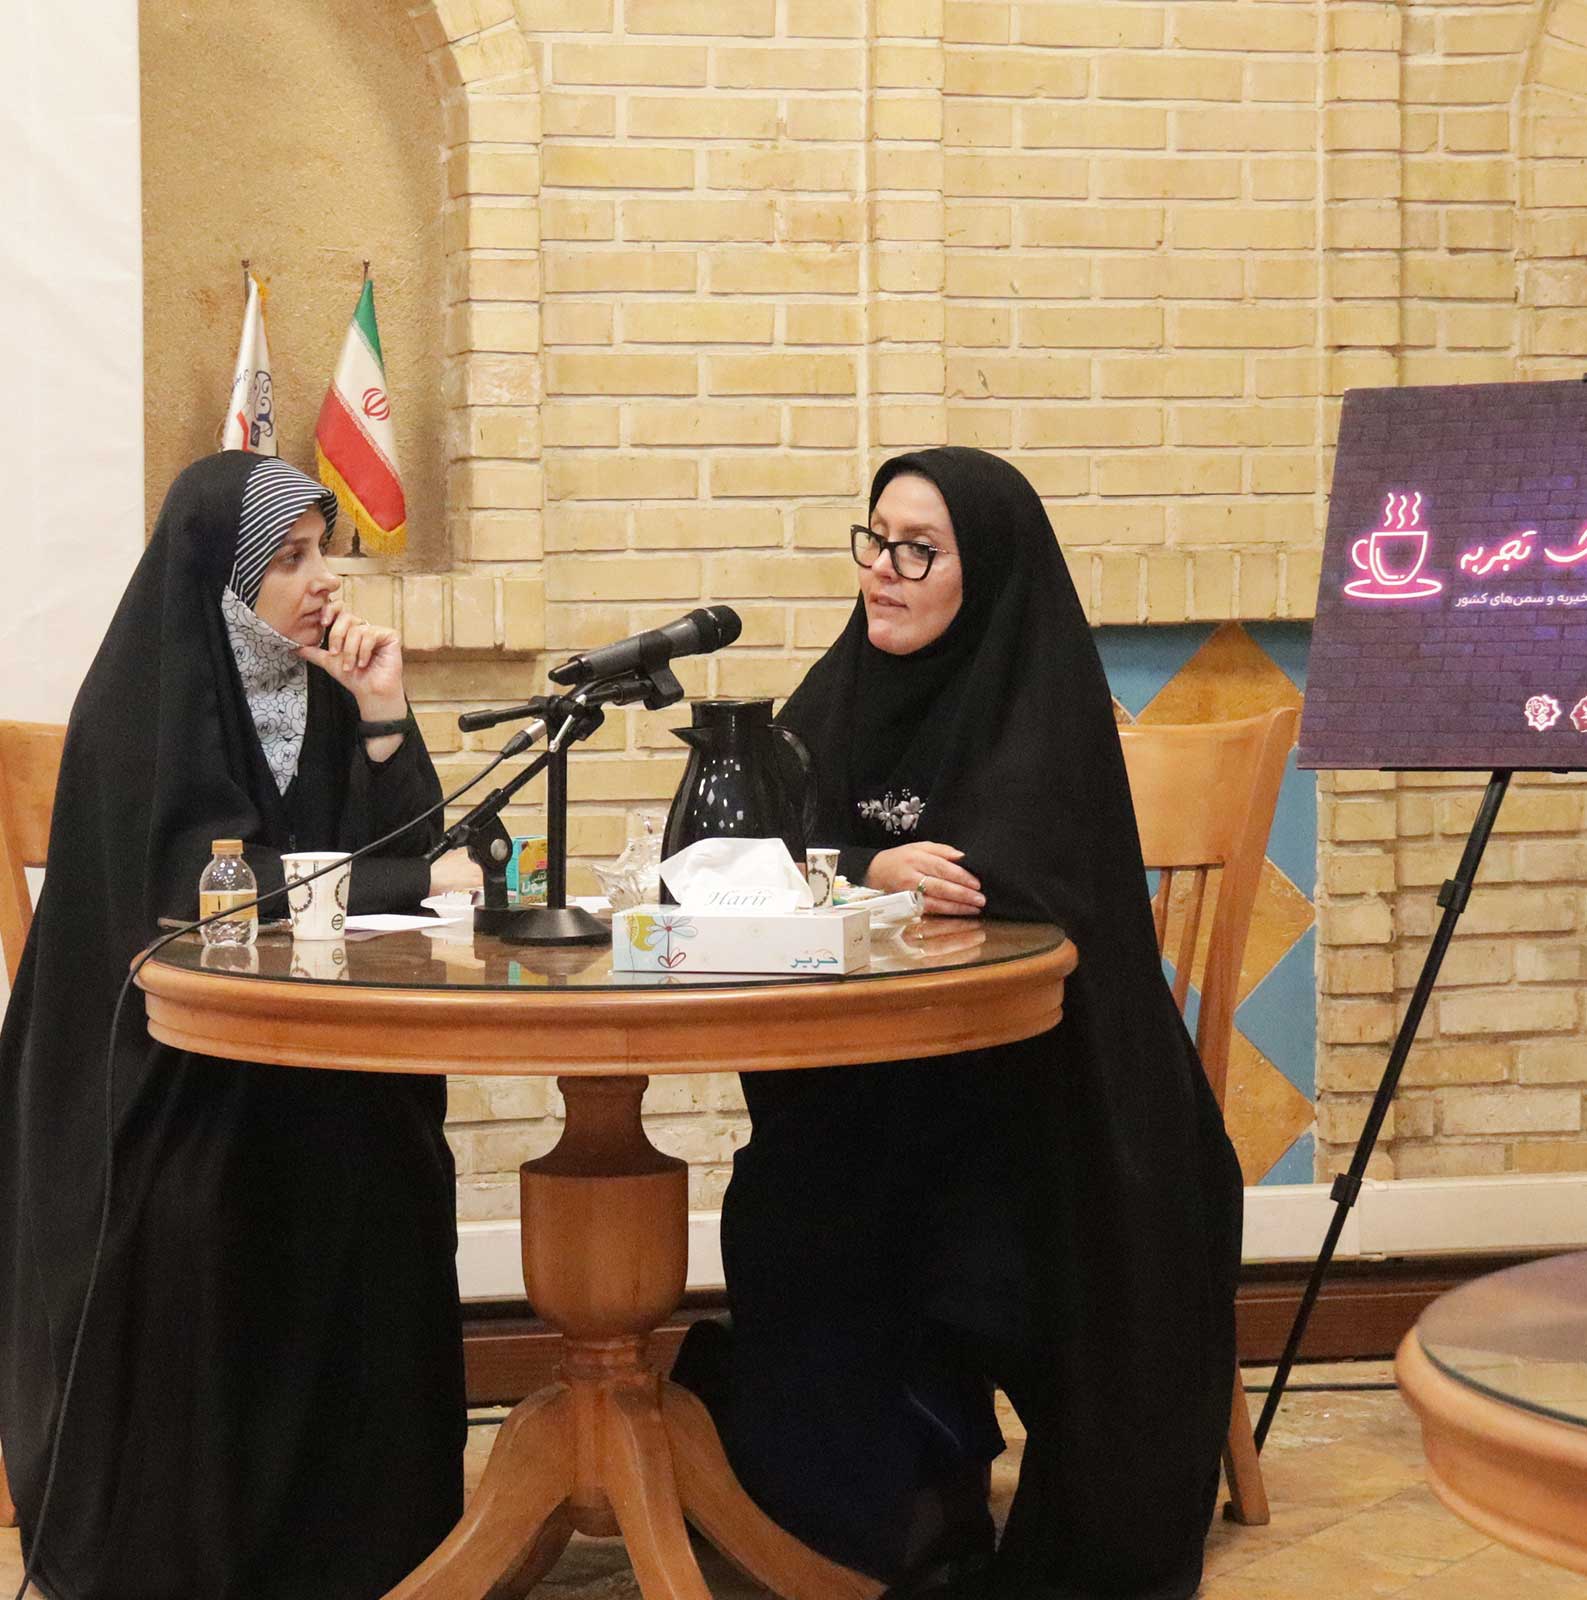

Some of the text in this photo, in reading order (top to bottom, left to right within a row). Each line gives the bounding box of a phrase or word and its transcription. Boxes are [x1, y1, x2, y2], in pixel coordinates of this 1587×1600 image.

[1460, 530, 1538, 575] تجربه
[1455, 592, 1488, 607] کشور
[1546, 595, 1555, 606] و
[707, 889, 772, 906] Harir
[790, 956, 839, 969] حریر
